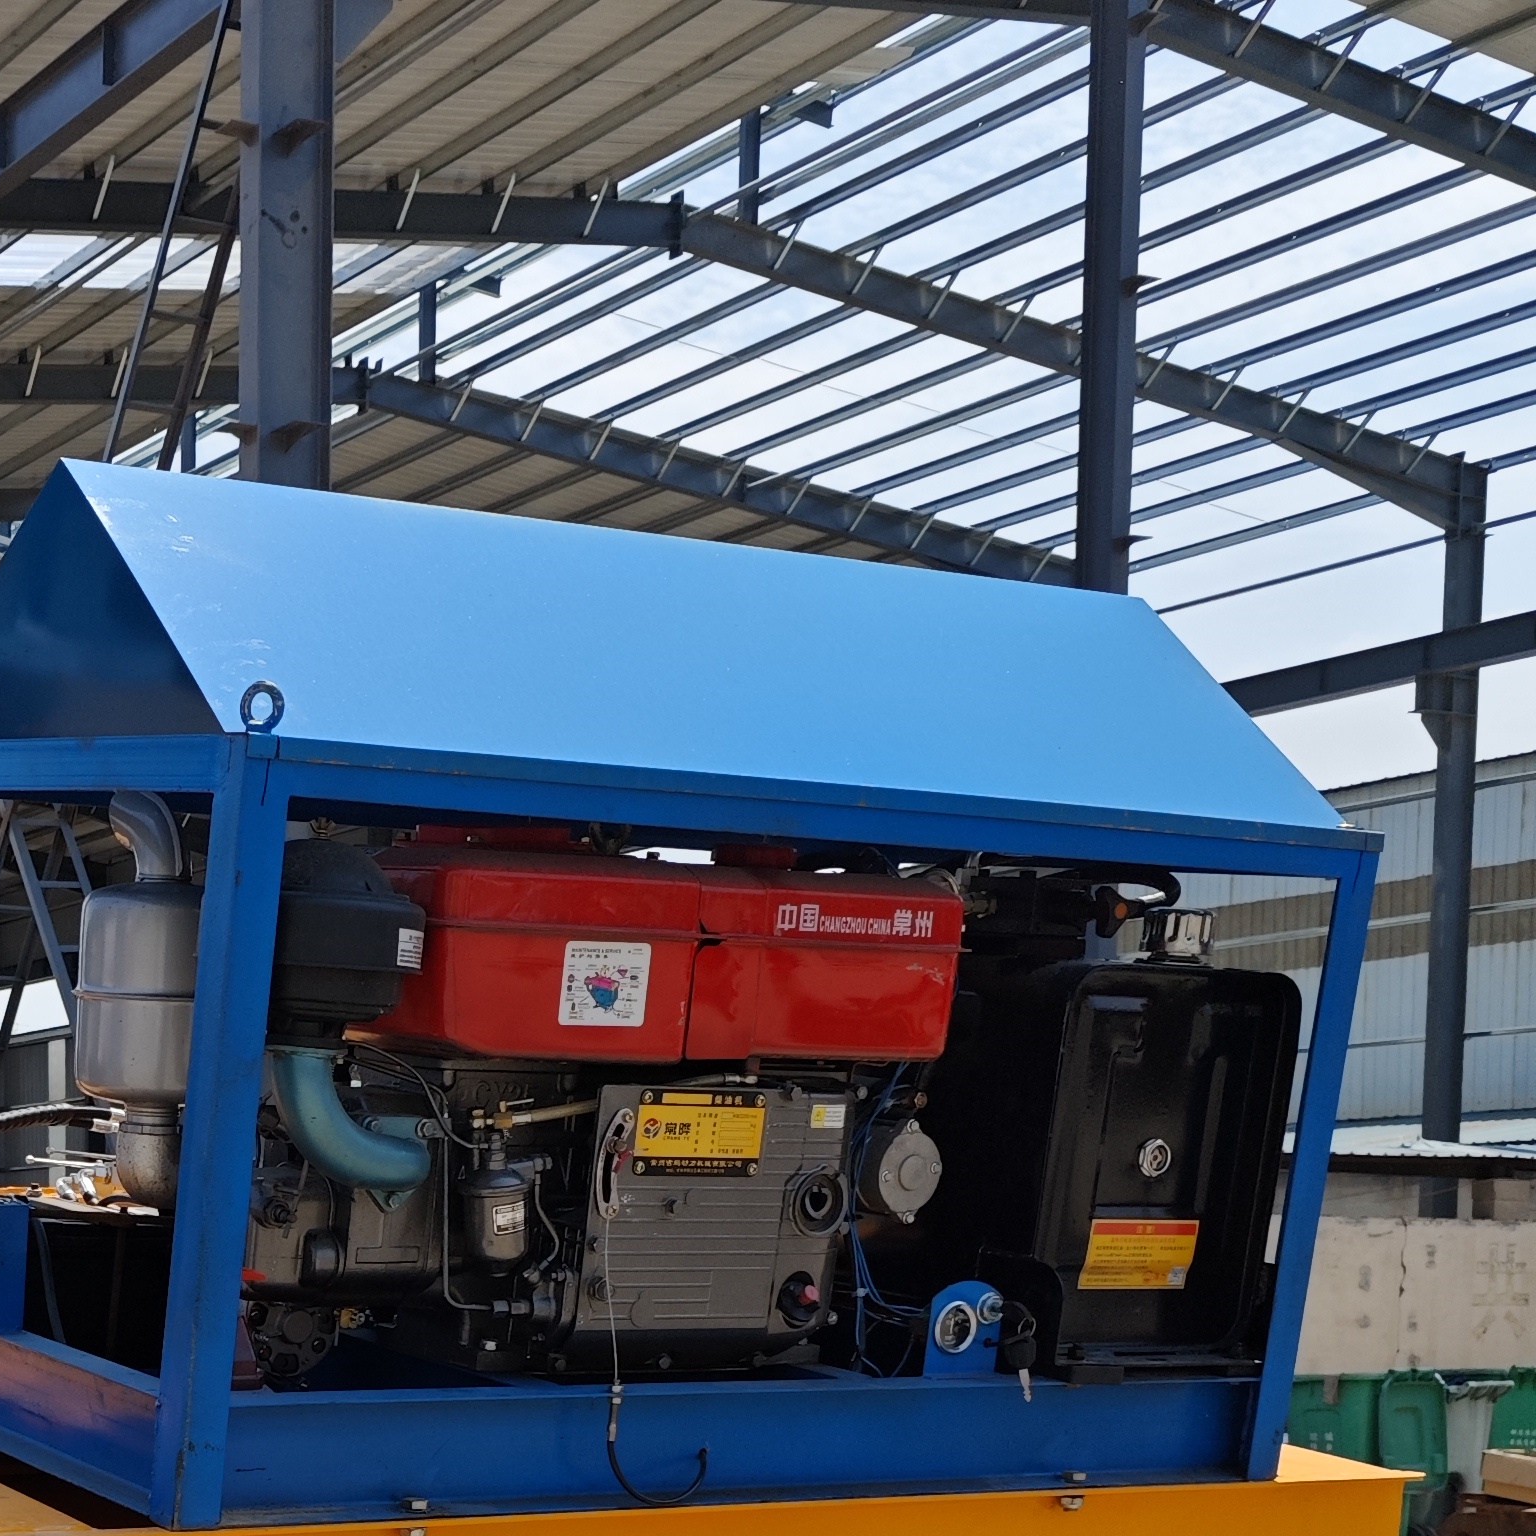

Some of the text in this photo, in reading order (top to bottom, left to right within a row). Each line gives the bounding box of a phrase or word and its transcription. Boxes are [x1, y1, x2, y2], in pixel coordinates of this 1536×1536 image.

[777, 903, 820, 932] 中国
[820, 915, 891, 936] CHANGZHOU CHINA
[892, 909, 934, 938] 常州
